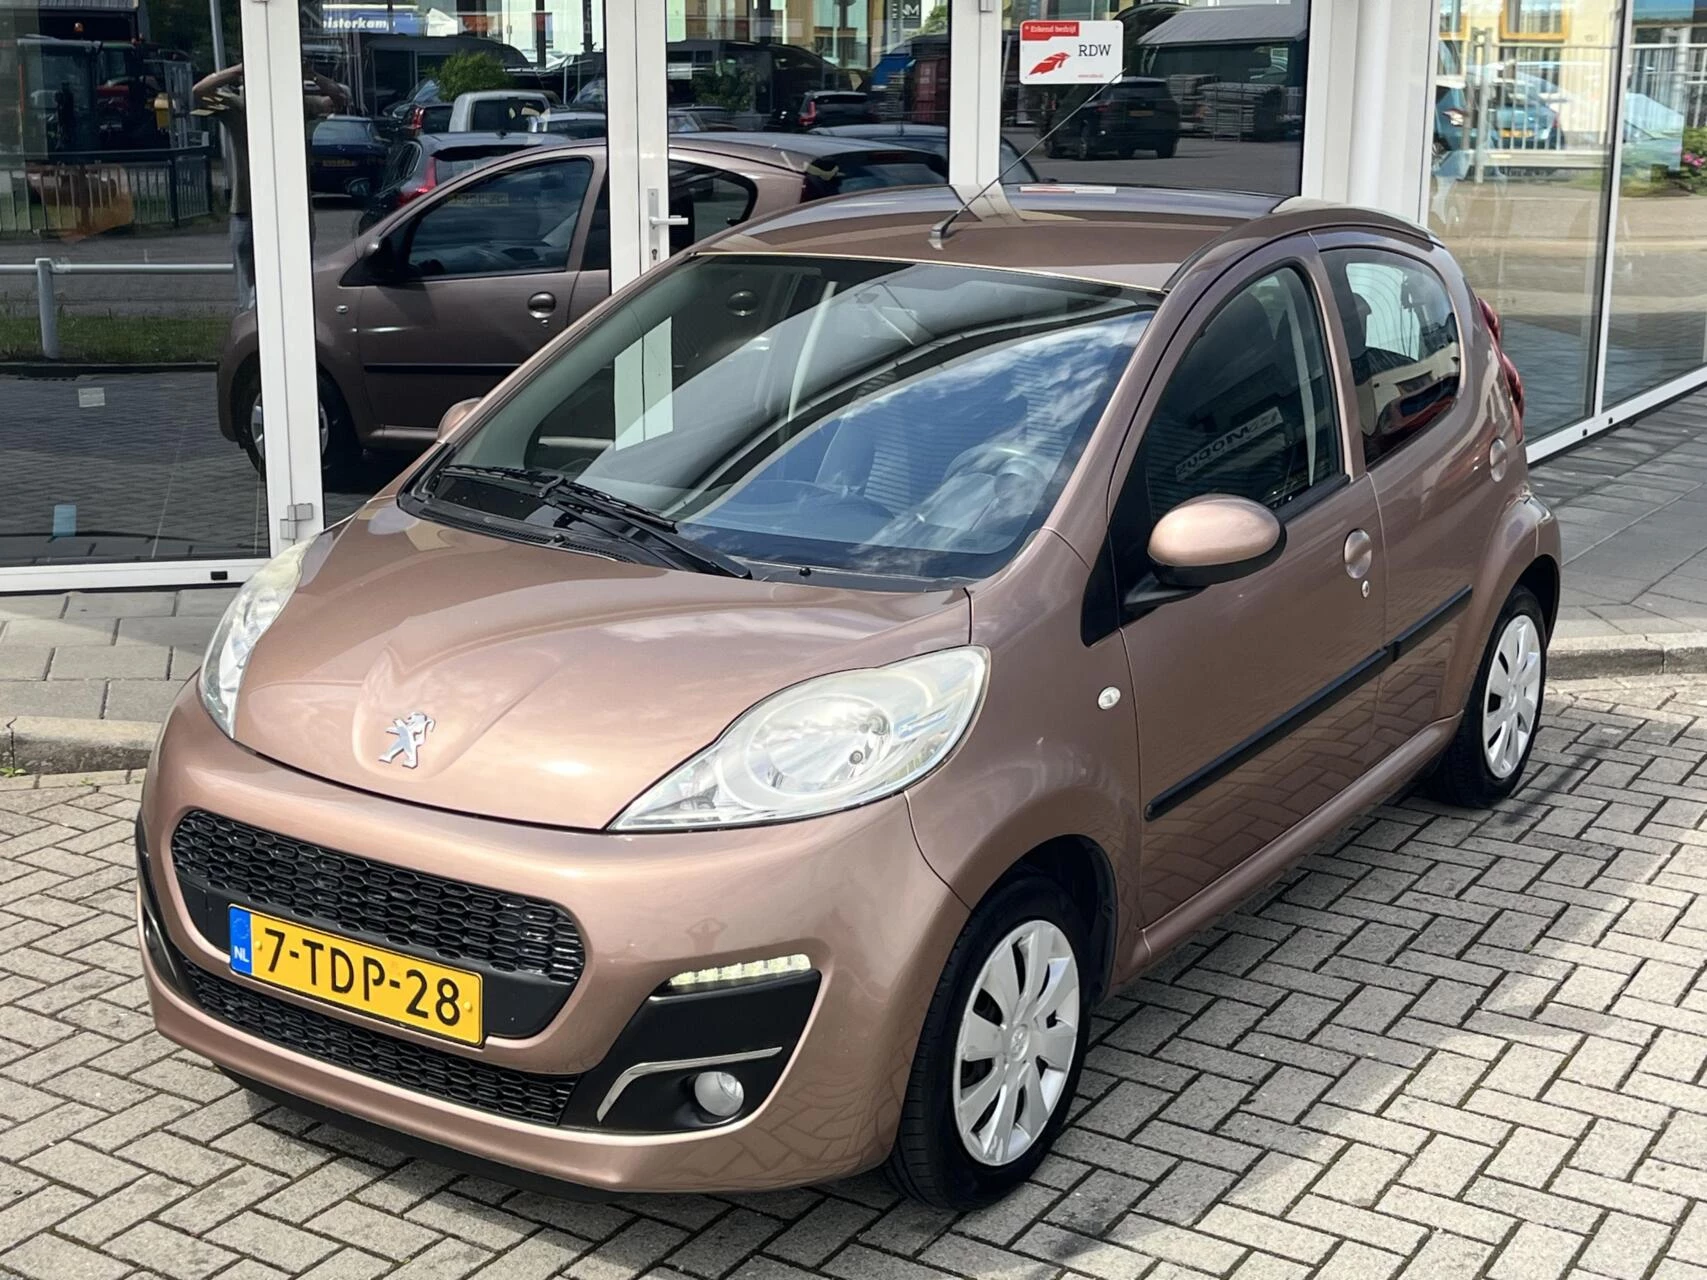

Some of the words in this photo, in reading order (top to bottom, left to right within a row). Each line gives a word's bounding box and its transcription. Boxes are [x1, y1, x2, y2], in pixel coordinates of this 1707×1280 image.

[1078, 44, 1112, 57] RDW
[233, 946, 249, 963] NL
[265, 928, 460, 1026] 7-TDP-28
